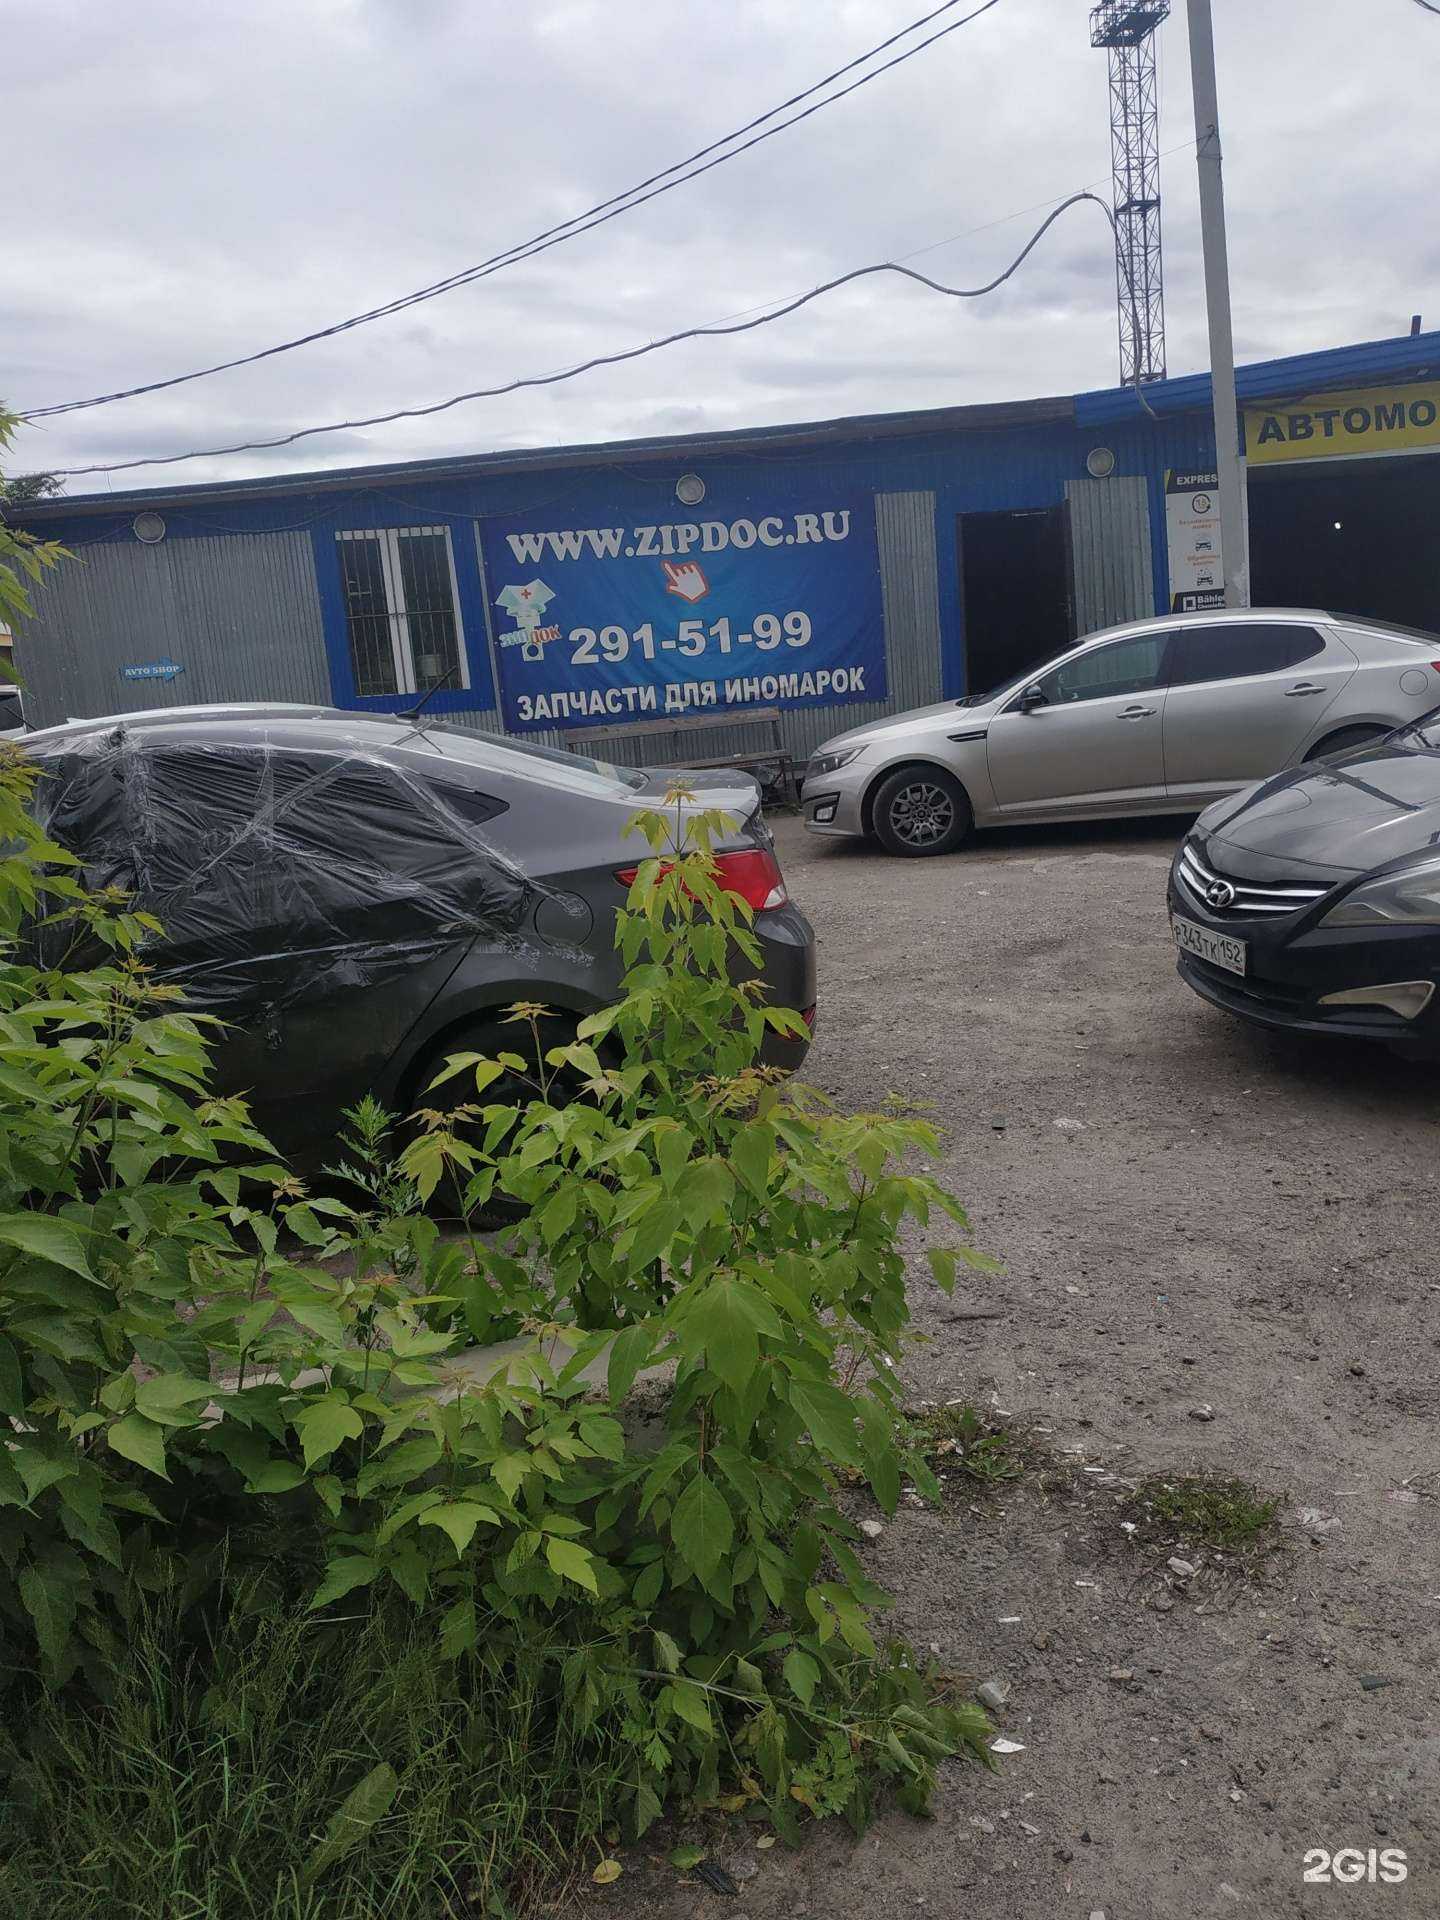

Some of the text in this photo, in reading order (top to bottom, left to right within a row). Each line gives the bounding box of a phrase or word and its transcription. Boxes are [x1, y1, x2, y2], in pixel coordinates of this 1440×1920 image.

[1256, 400, 1437, 445] АВТОМО
[505, 510, 851, 564] WWW.ZIPDOC.RU
[568, 610, 813, 665] 291-51-99
[516, 666, 866, 722] ЗАПЧАСТИ ДЛЯ ИНОМАРОК
